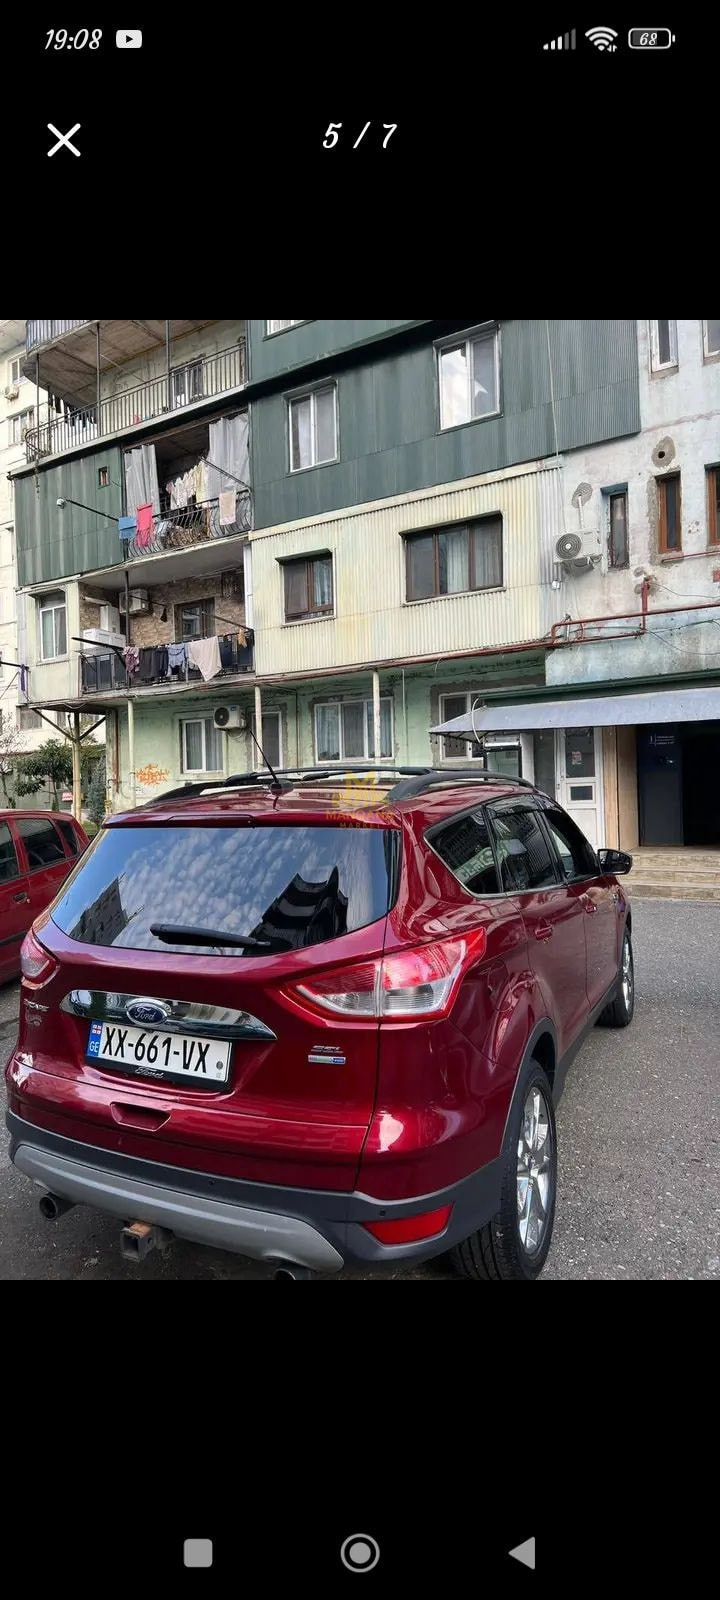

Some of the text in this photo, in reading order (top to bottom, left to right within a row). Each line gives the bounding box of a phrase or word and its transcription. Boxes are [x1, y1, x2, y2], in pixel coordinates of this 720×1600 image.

[134, 1006, 156, 1019] Ford
[89, 1040, 99, 1053] GE
[102, 1026, 210, 1073] XX-661-VX
